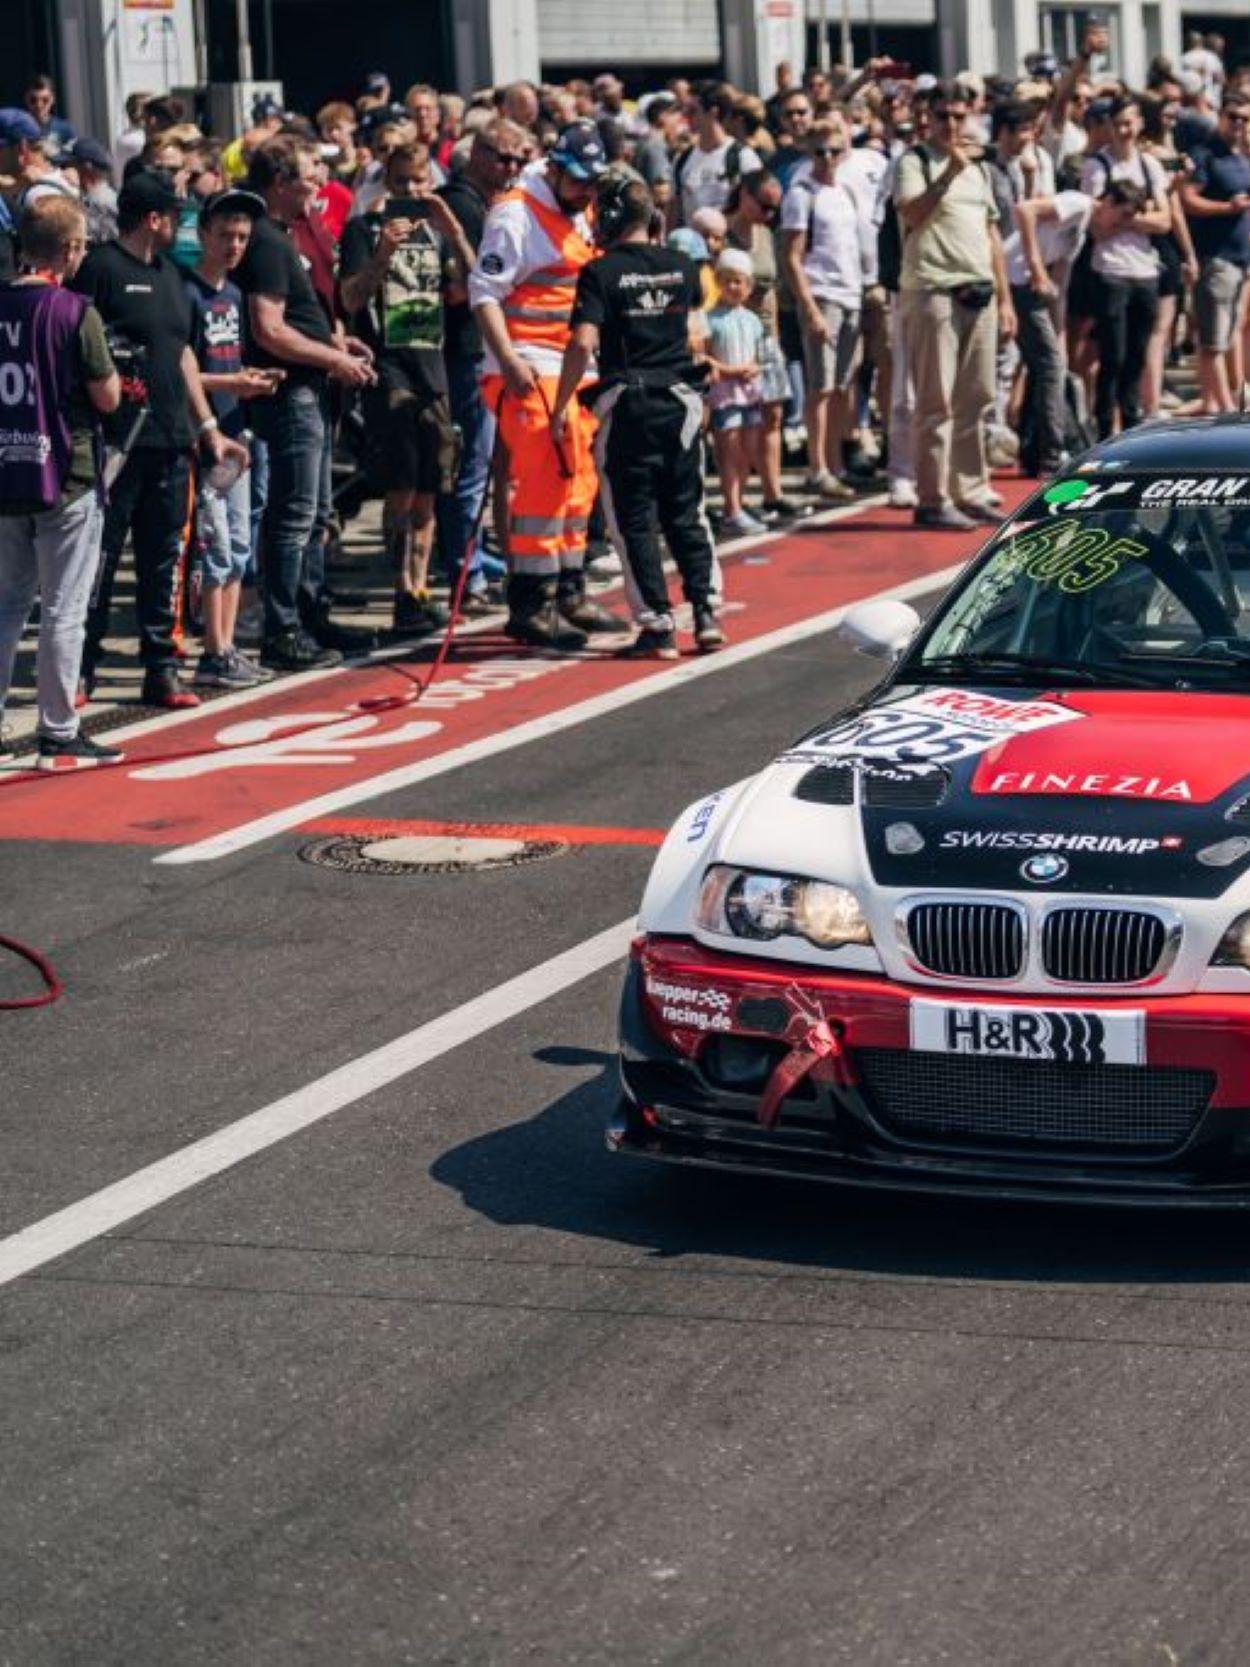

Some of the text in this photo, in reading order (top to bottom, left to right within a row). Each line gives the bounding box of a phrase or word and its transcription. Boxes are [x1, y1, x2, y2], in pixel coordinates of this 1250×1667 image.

[1140, 477, 1250, 498] GRAN
[934, 691, 1059, 722] ROWE
[812, 713, 996, 764] 605
[990, 772, 1192, 800] FINEZIA
[939, 830, 1160, 855] SWISSSHRIMP
[662, 1003, 732, 1031] racing.de
